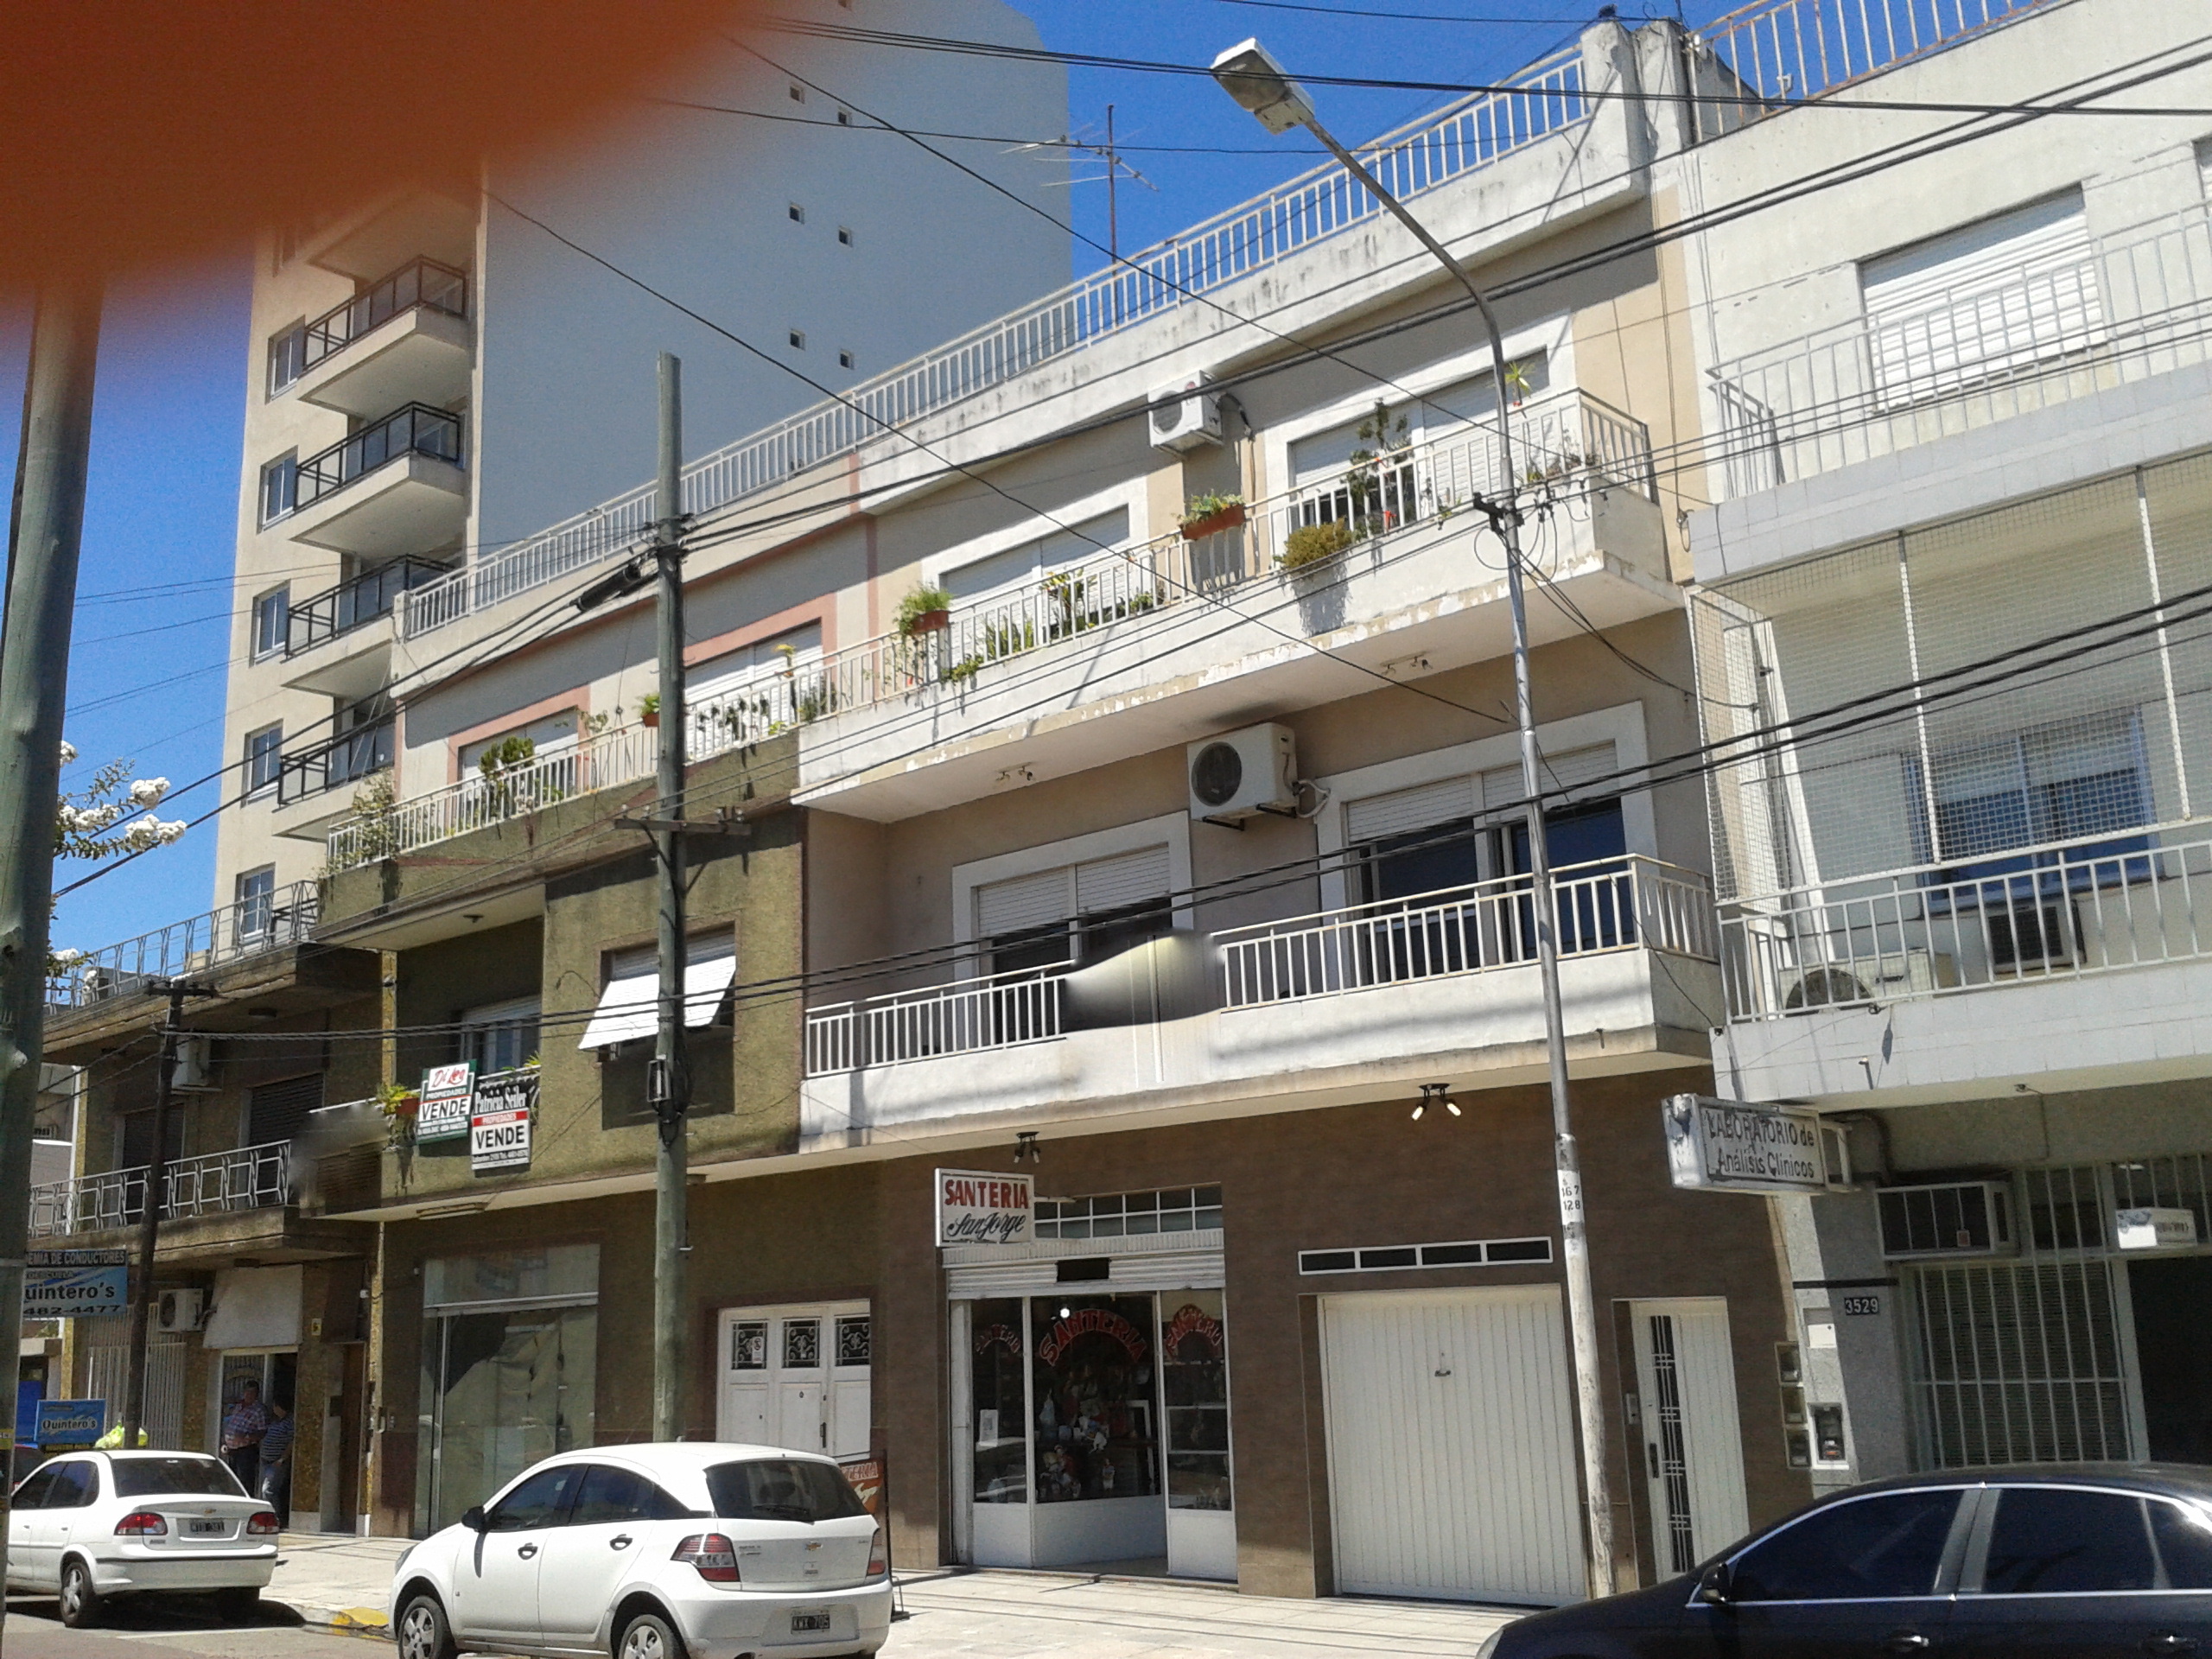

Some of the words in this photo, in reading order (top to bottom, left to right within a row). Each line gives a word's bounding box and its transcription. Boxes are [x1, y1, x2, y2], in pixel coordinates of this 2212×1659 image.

[422, 1098, 467, 1121] VENDE
[475, 1124, 525, 1150] VENDE
[1705, 1110, 1798, 1147] LABORATORIO
[1799, 1124, 1815, 1147] de
[944, 1179, 1030, 1210] SANTERIA
[51, 1253, 62, 1264] DE
[64, 1252, 125, 1264] CONDUCTORES
[24, 1281, 115, 1300] uintero's
[1845, 1298, 1879, 1314] 3529
[1039, 1307, 1147, 1367] SANTERIA
[42, 1417, 97, 1430] Quintero's
